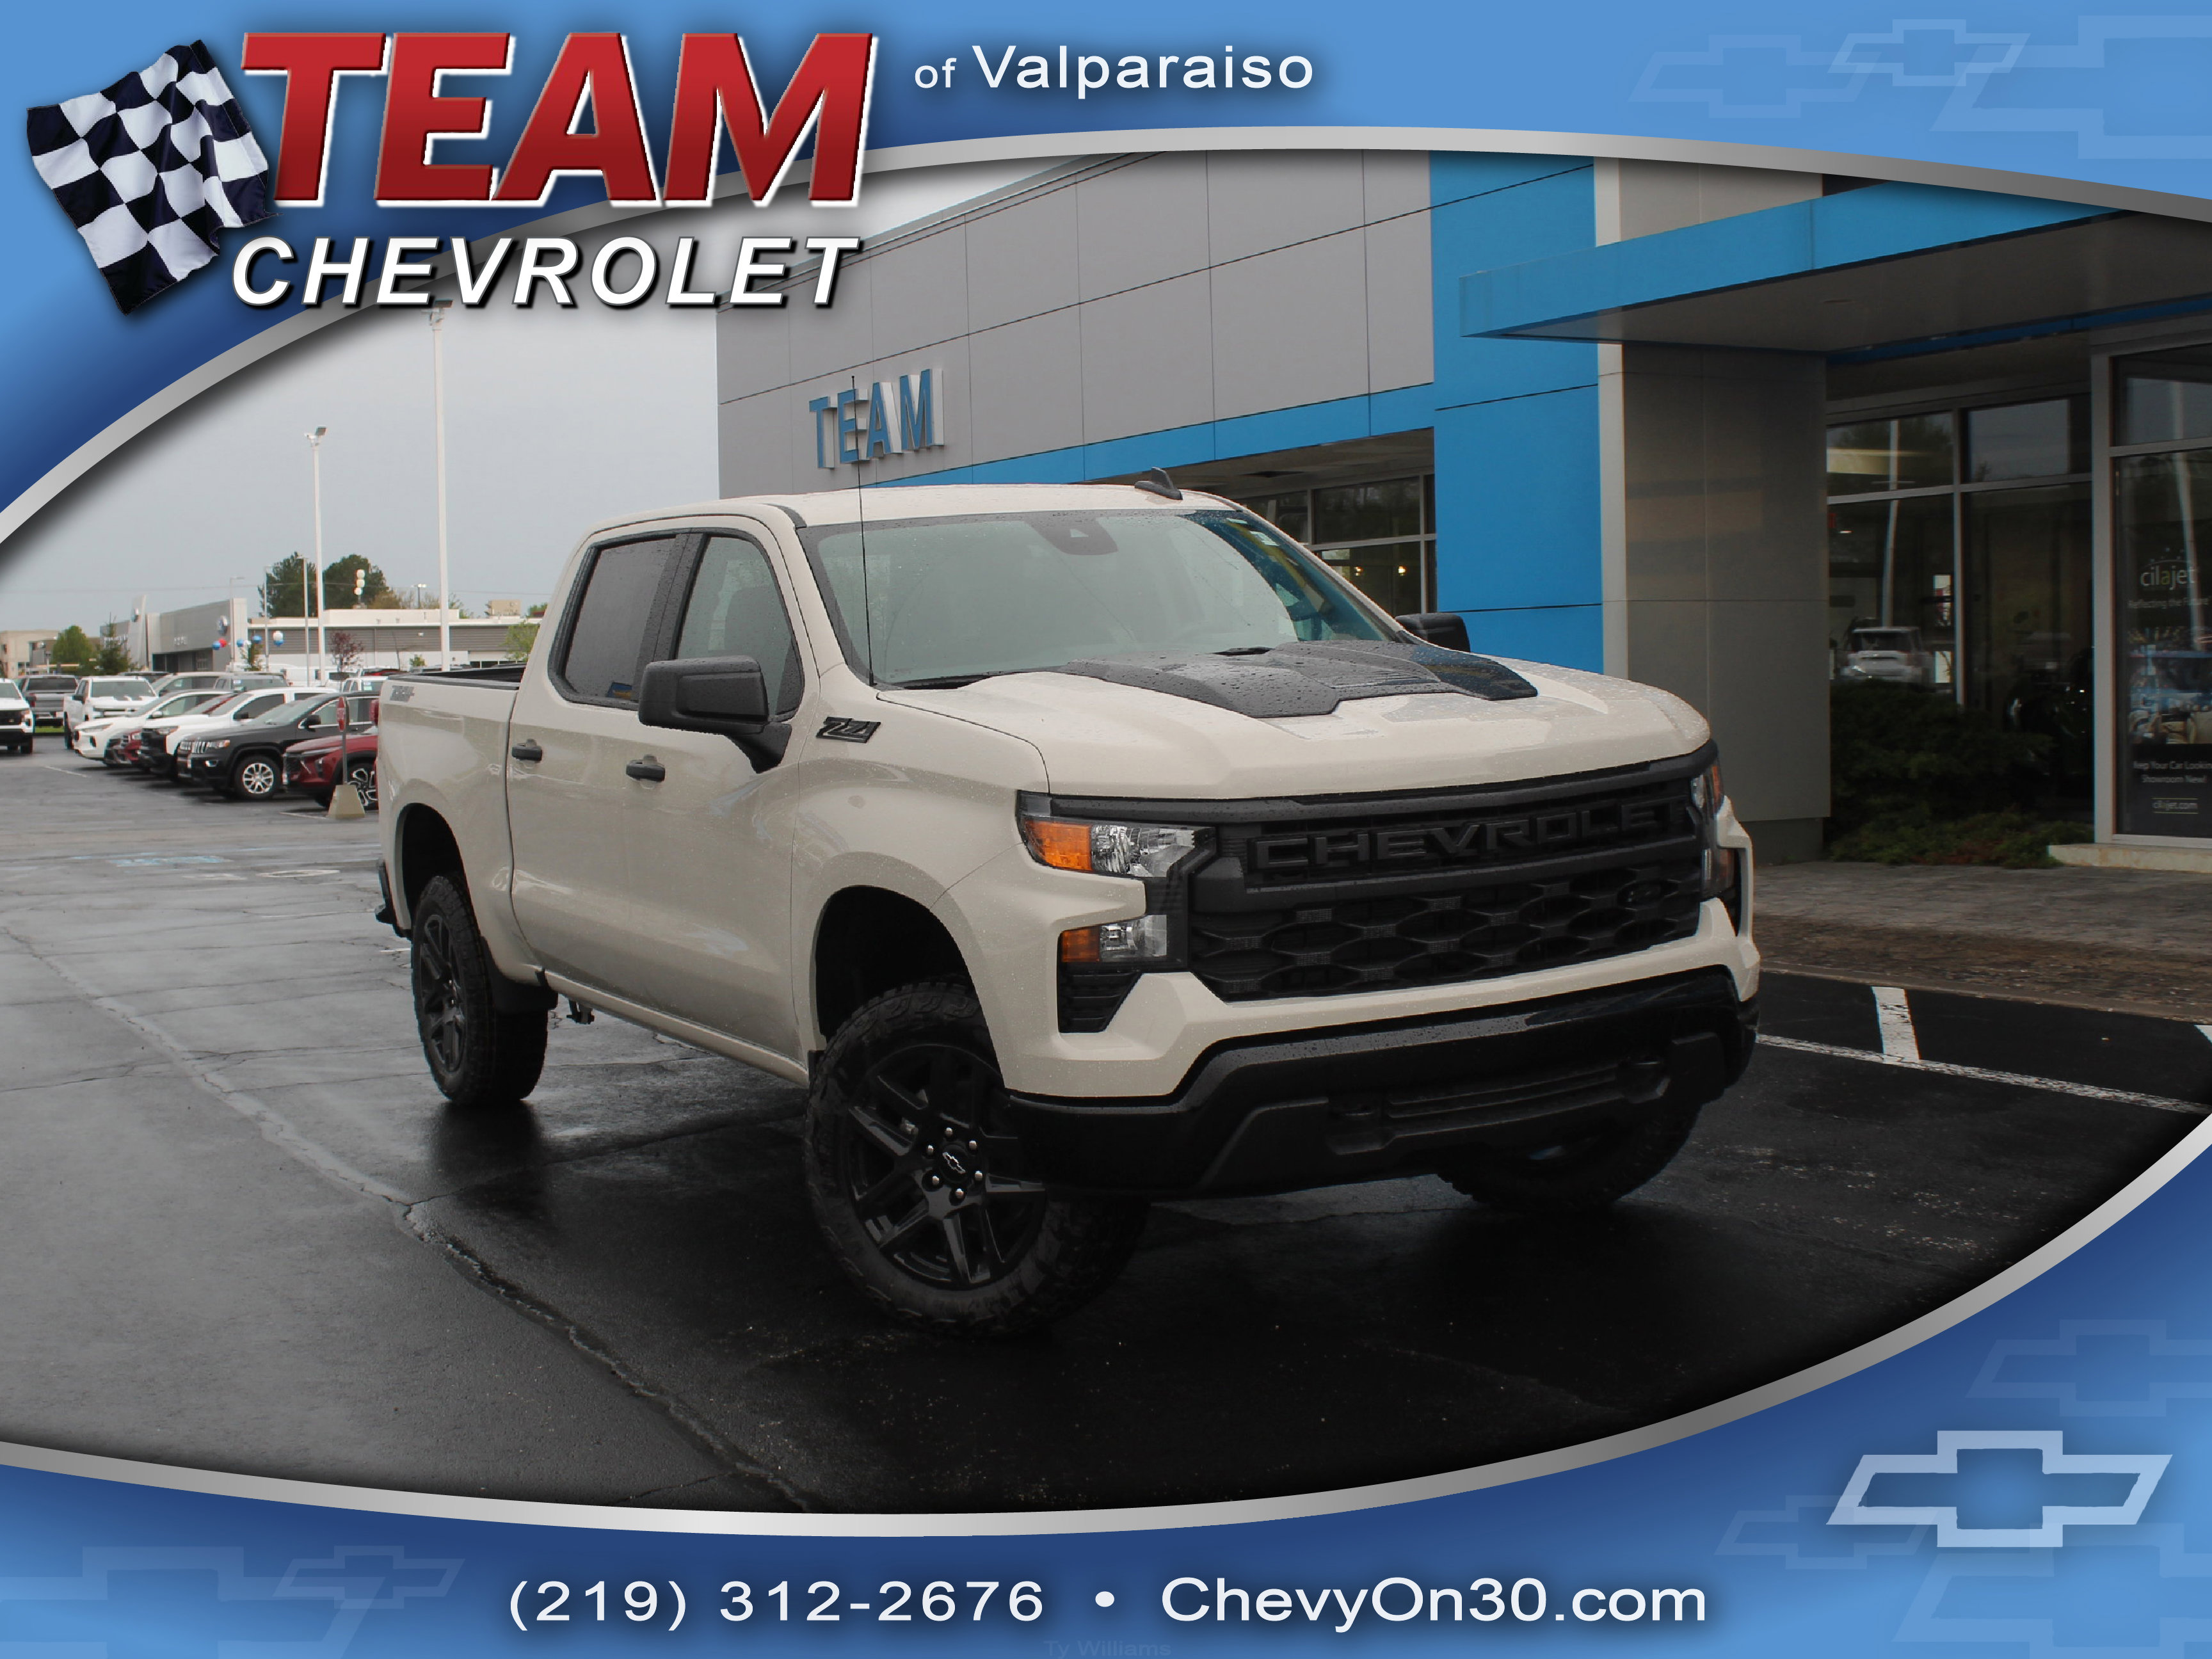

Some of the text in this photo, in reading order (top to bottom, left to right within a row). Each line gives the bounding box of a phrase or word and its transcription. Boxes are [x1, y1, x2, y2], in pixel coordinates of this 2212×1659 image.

[809, 369, 945, 469] TEAM
[2140, 565, 2196, 590] cilajet
[1249, 796, 1687, 870] CHEVROLET
